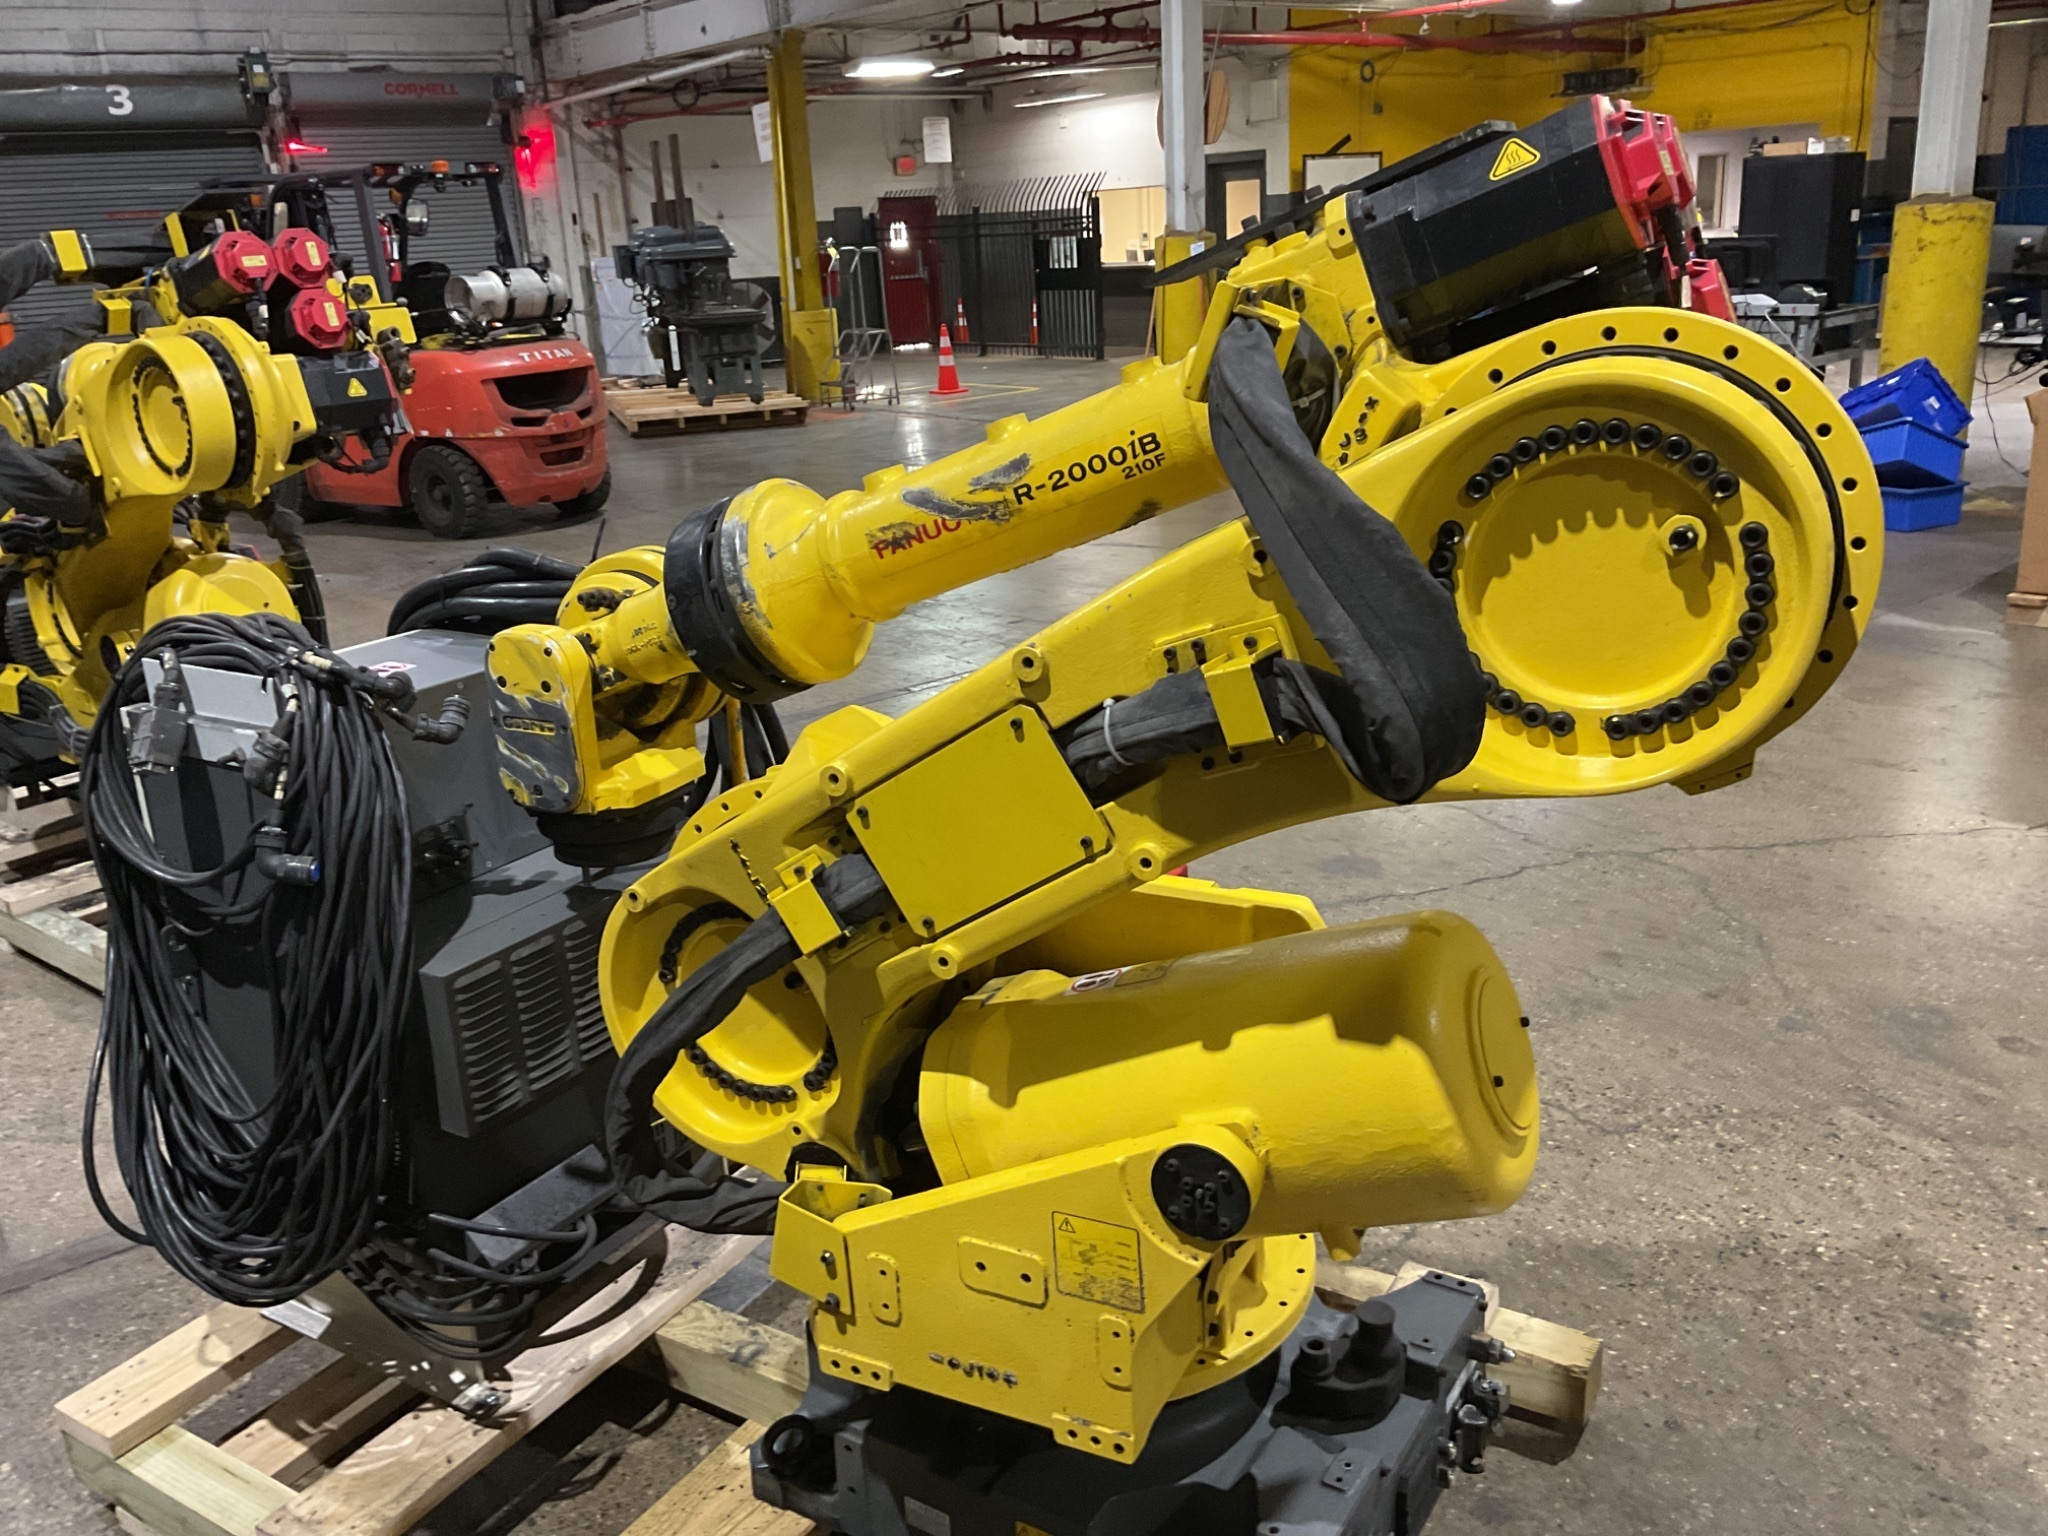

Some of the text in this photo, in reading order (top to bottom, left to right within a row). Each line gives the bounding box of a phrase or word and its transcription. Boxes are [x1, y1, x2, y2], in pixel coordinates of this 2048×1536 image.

[105, 84, 134, 116] 3
[384, 81, 460, 98] CORNELL
[518, 348, 574, 363] TITAN
[1121, 452, 1166, 480] 210F
[874, 429, 1161, 560] FANUC R-2000iB
